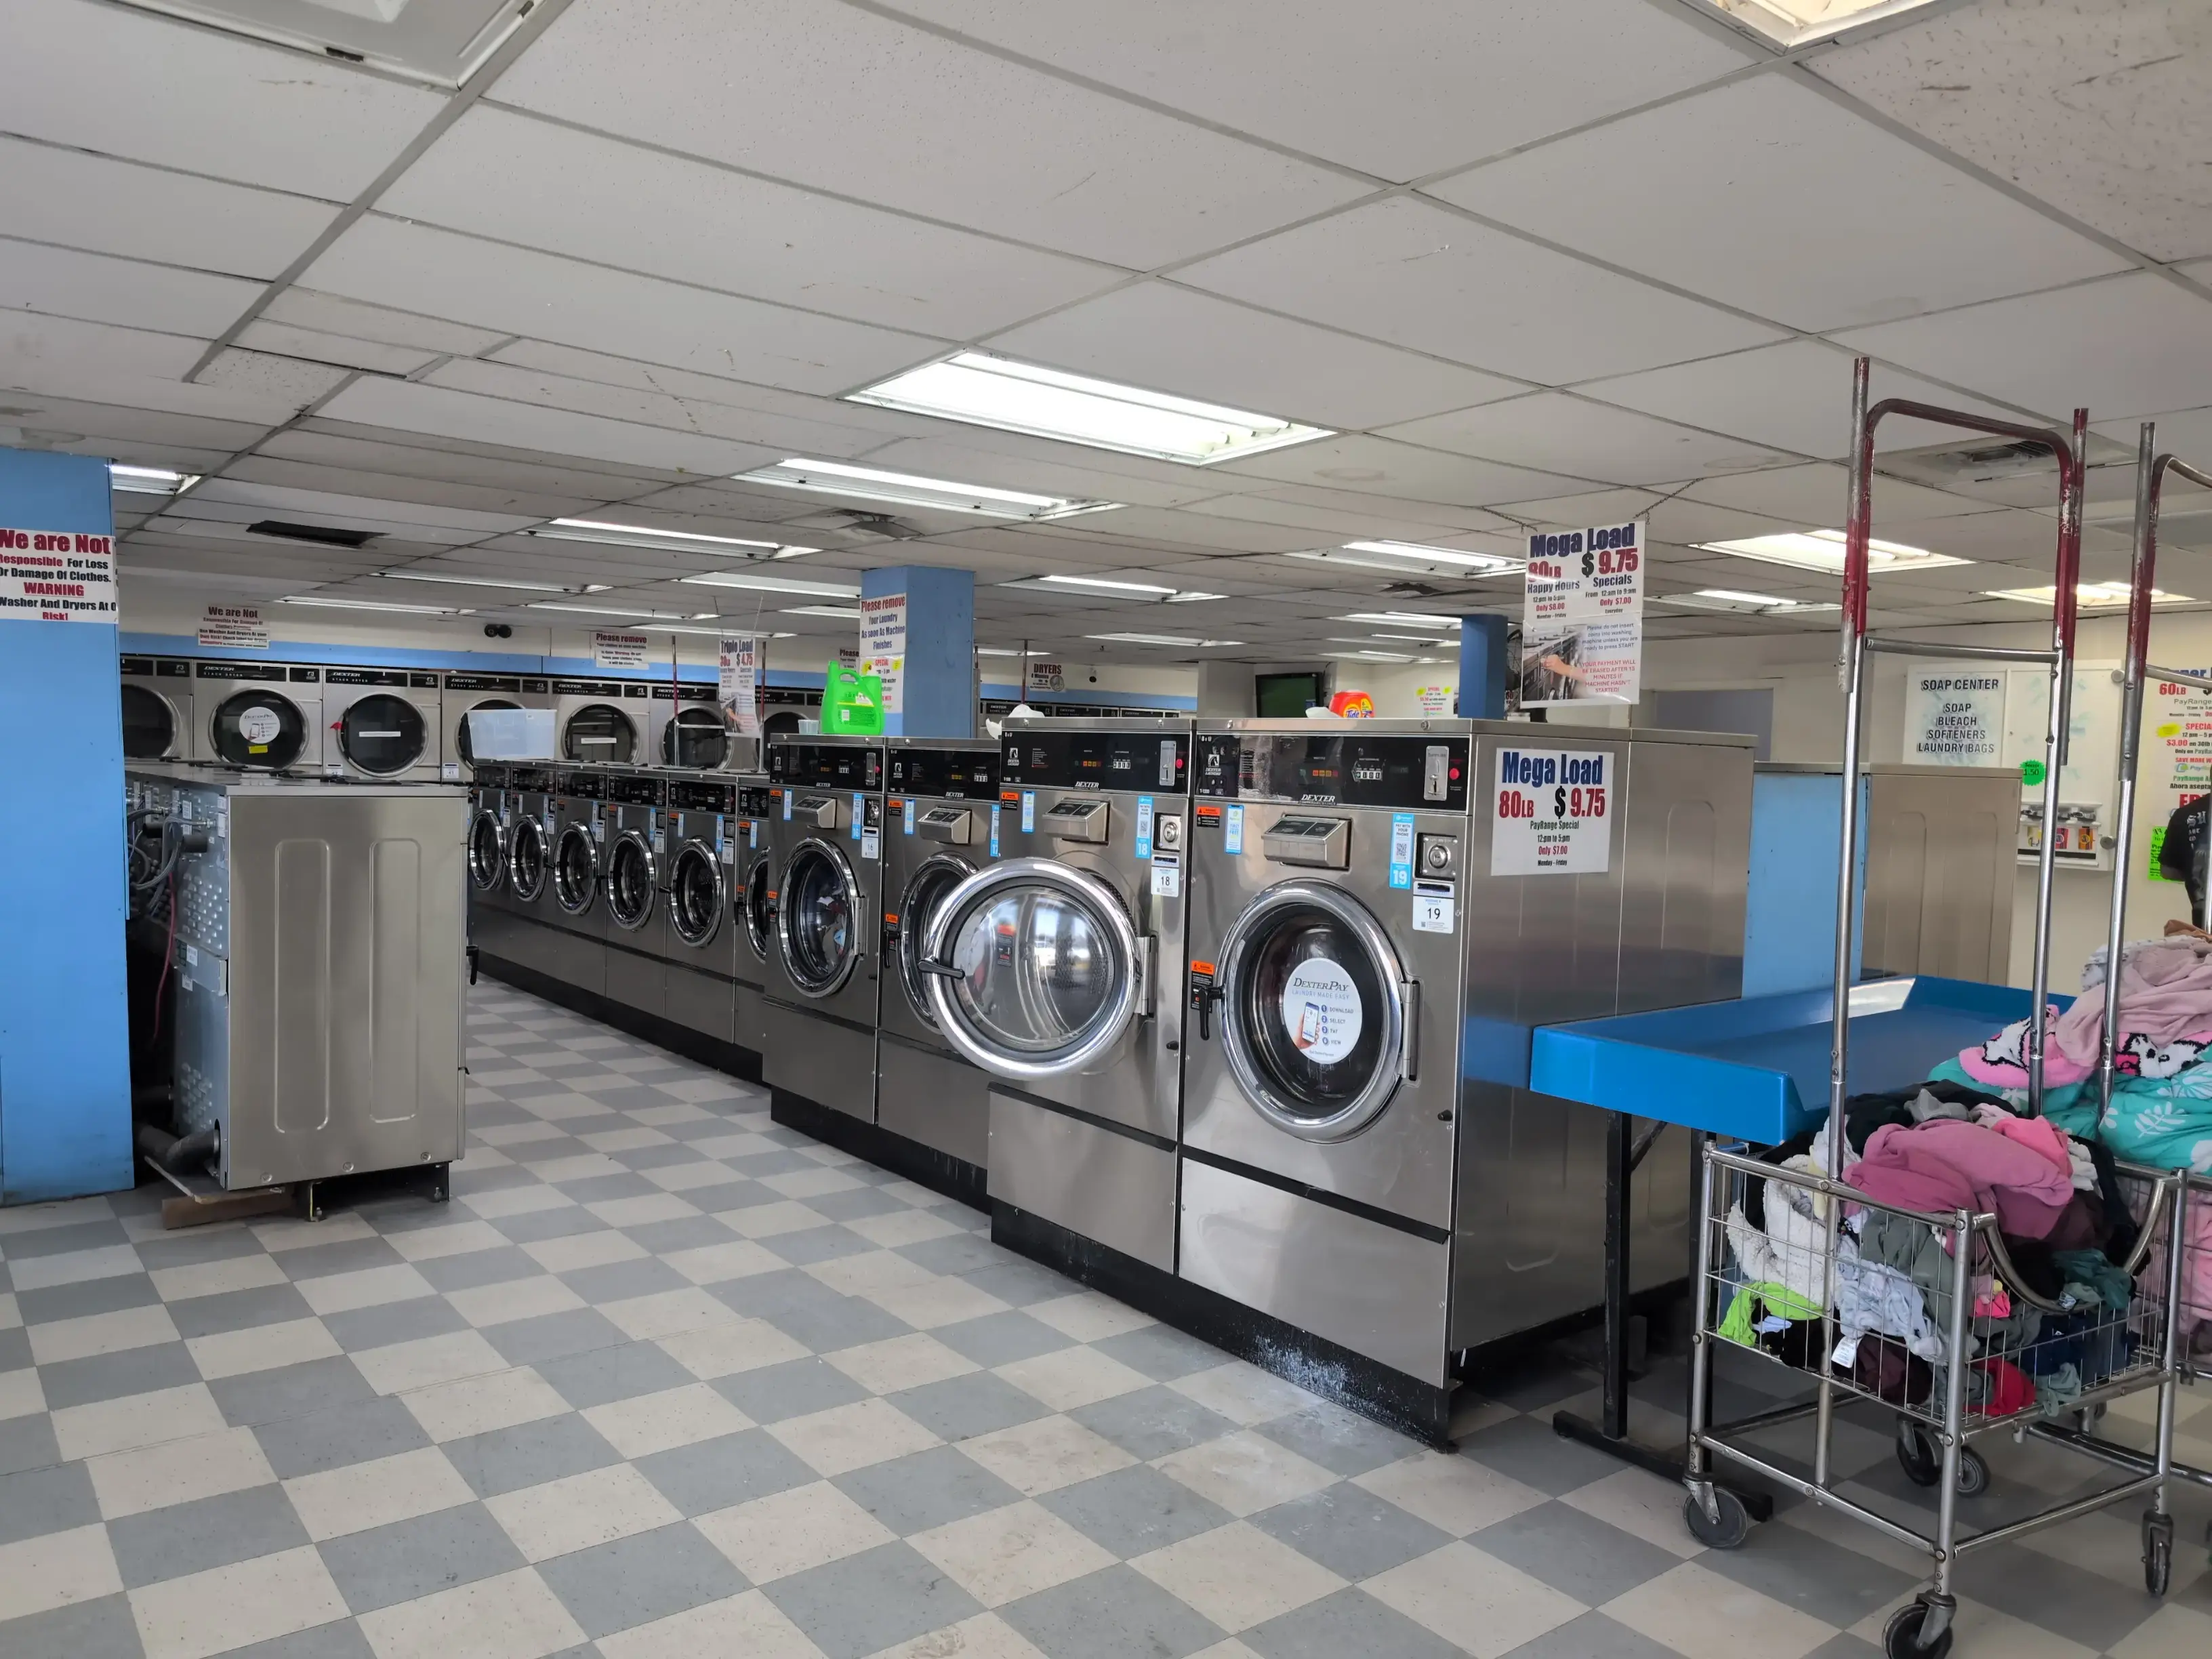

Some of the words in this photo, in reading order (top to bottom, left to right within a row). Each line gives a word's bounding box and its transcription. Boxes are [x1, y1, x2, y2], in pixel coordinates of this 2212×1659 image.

[0, 529, 28, 550] We
[34, 534, 70, 552] are
[75, 535, 111, 554] Not
[1530, 533, 1582, 558] Mega
[1587, 523, 1635, 552] Load
[67, 558, 83, 568] For
[86, 560, 108, 569] Loss
[1582, 551, 1594, 577] $
[1599, 548, 1639, 575] 9.75
[11, 568, 54, 579] Damage
[56, 571, 67, 580] Of
[70, 571, 111, 582] Clothes.
[1528, 583, 1553, 594] Happy
[1555, 580, 1580, 591] Hours
[1593, 575, 1633, 588] Specials
[24, 582, 84, 596] WARNING
[0, 596, 38, 608] Washer
[41, 598, 60, 609] And
[63, 600, 96, 611] Dryers
[98, 602, 108, 611] At
[861, 600, 882, 613] Please
[882, 596, 905, 610] remove
[1536, 604, 1548, 612] Only
[1600, 598, 1613, 607] Only
[208, 607, 224, 615] We
[226, 609, 241, 617] are
[243, 609, 258, 618] Not
[869, 616, 879, 625] Your
[879, 613, 898, 623] Laundry
[861, 630, 867, 638] As
[867, 629, 879, 638] soon
[880, 628, 885, 636] As
[886, 626, 905, 636] Machine
[596, 633, 620, 642] Please
[621, 636, 647, 644] remove
[720, 640, 738, 654] Triple
[739, 639, 754, 653] Load
[873, 640, 893, 650] Finishes
[840, 649, 859, 657] Please
[741, 653, 753, 666] 4.75
[1033, 663, 1062, 675] DRYERS
[1921, 680, 1952, 691] SOAP
[1953, 679, 1999, 690] CENTER
[2159, 683, 2186, 695] 60LB
[1346, 710, 1359, 718] Tide
[1943, 703, 1971, 713] SOAP
[1936, 716, 1978, 726] BLEACH
[1926, 730, 1986, 739] SOFTENERS
[1917, 743, 1965, 753] LAUNDRY
[1965, 743, 1994, 753] BAGS
[1502, 752, 1555, 788] Mega
[1560, 754, 1603, 785] Load
[1498, 790, 1534, 819] 80LB
[1554, 785, 1566, 819] $
[1570, 787, 1605, 817] 9.75
[1530, 821, 1557, 831] PayRange
[1558, 820, 1579, 830] Special
[1553, 834, 1557, 842] to
[867, 843, 874, 851] 16
[1138, 843, 1149, 856] 18
[1538, 846, 1551, 856] Only
[1553, 845, 1568, 855] $7.00
[1160, 876, 1170, 886] 18
[1393, 869, 1408, 885] 19
[1427, 907, 1441, 920] 19
[1292, 989, 1316, 997] LAUNDRY
